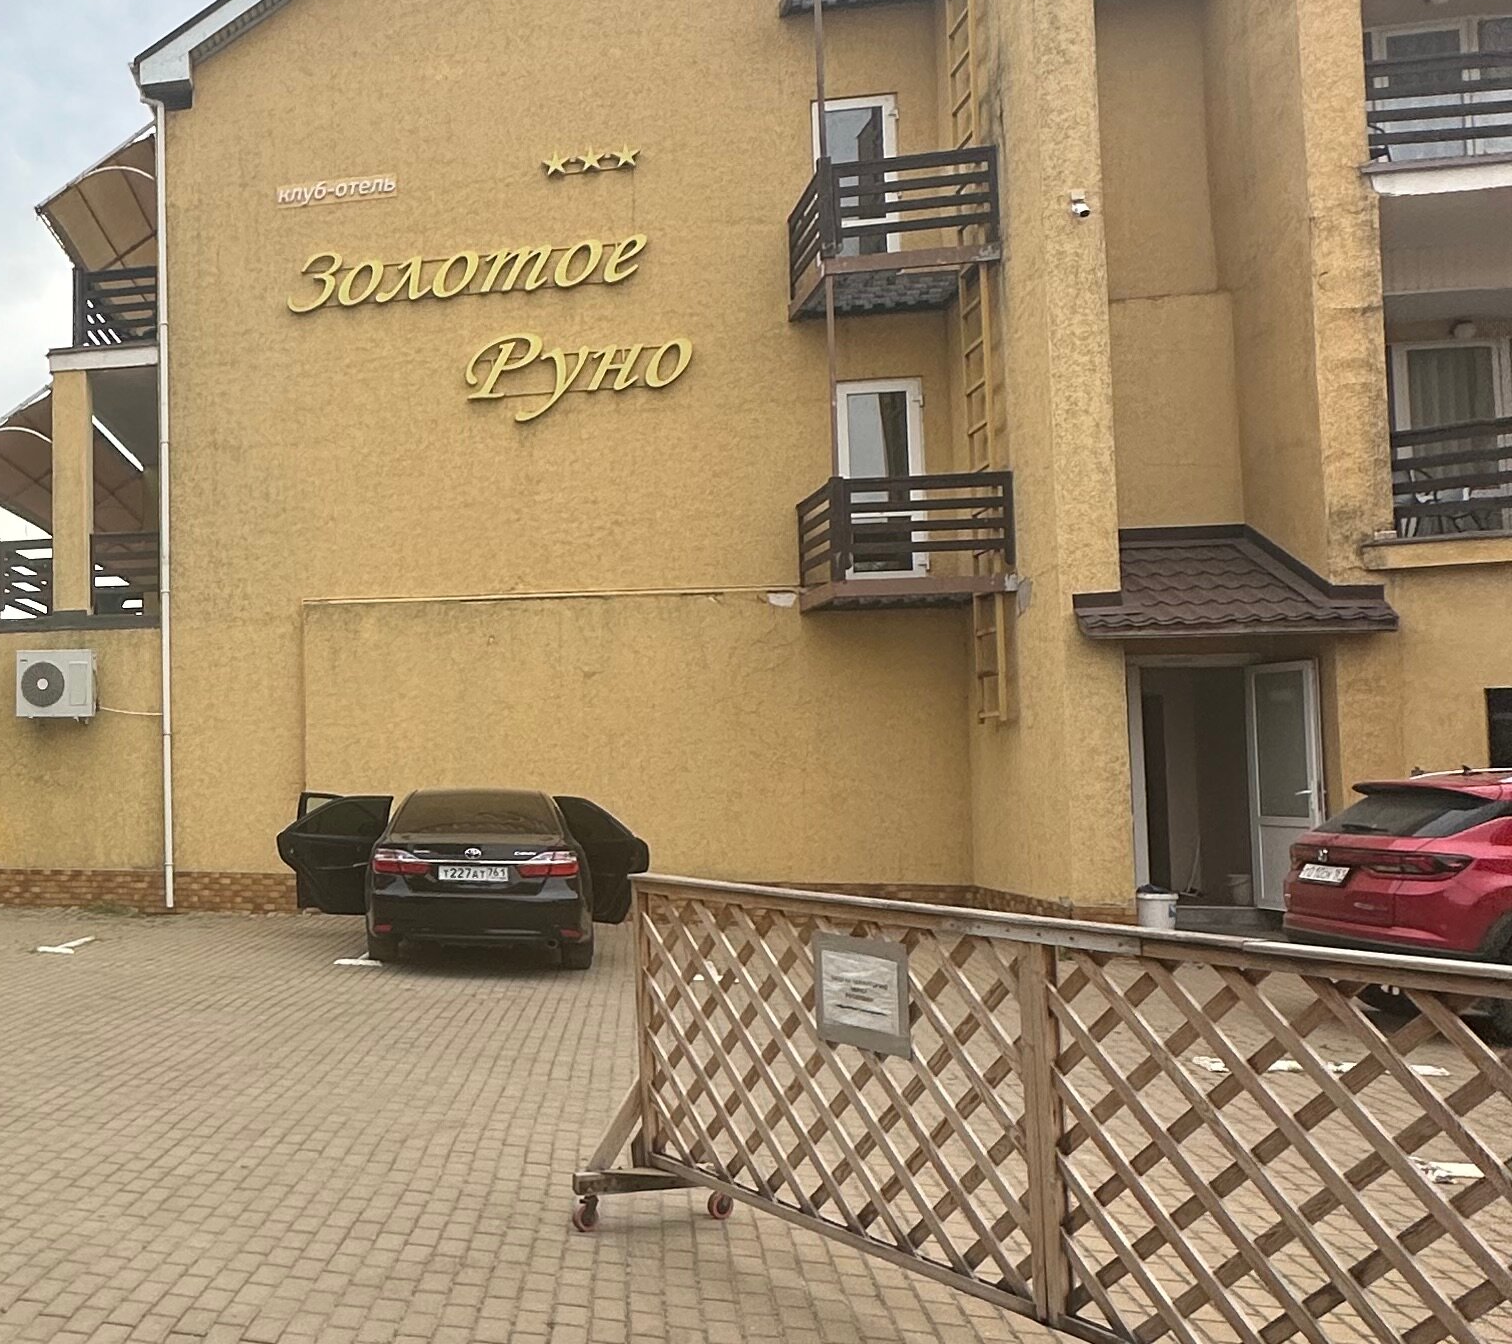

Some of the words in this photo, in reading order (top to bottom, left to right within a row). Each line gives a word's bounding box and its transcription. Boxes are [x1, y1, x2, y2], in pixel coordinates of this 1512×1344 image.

[277, 177, 396, 207] клуб-отель
[287, 233, 648, 313] Золотое
[464, 332, 693, 422] Руно
